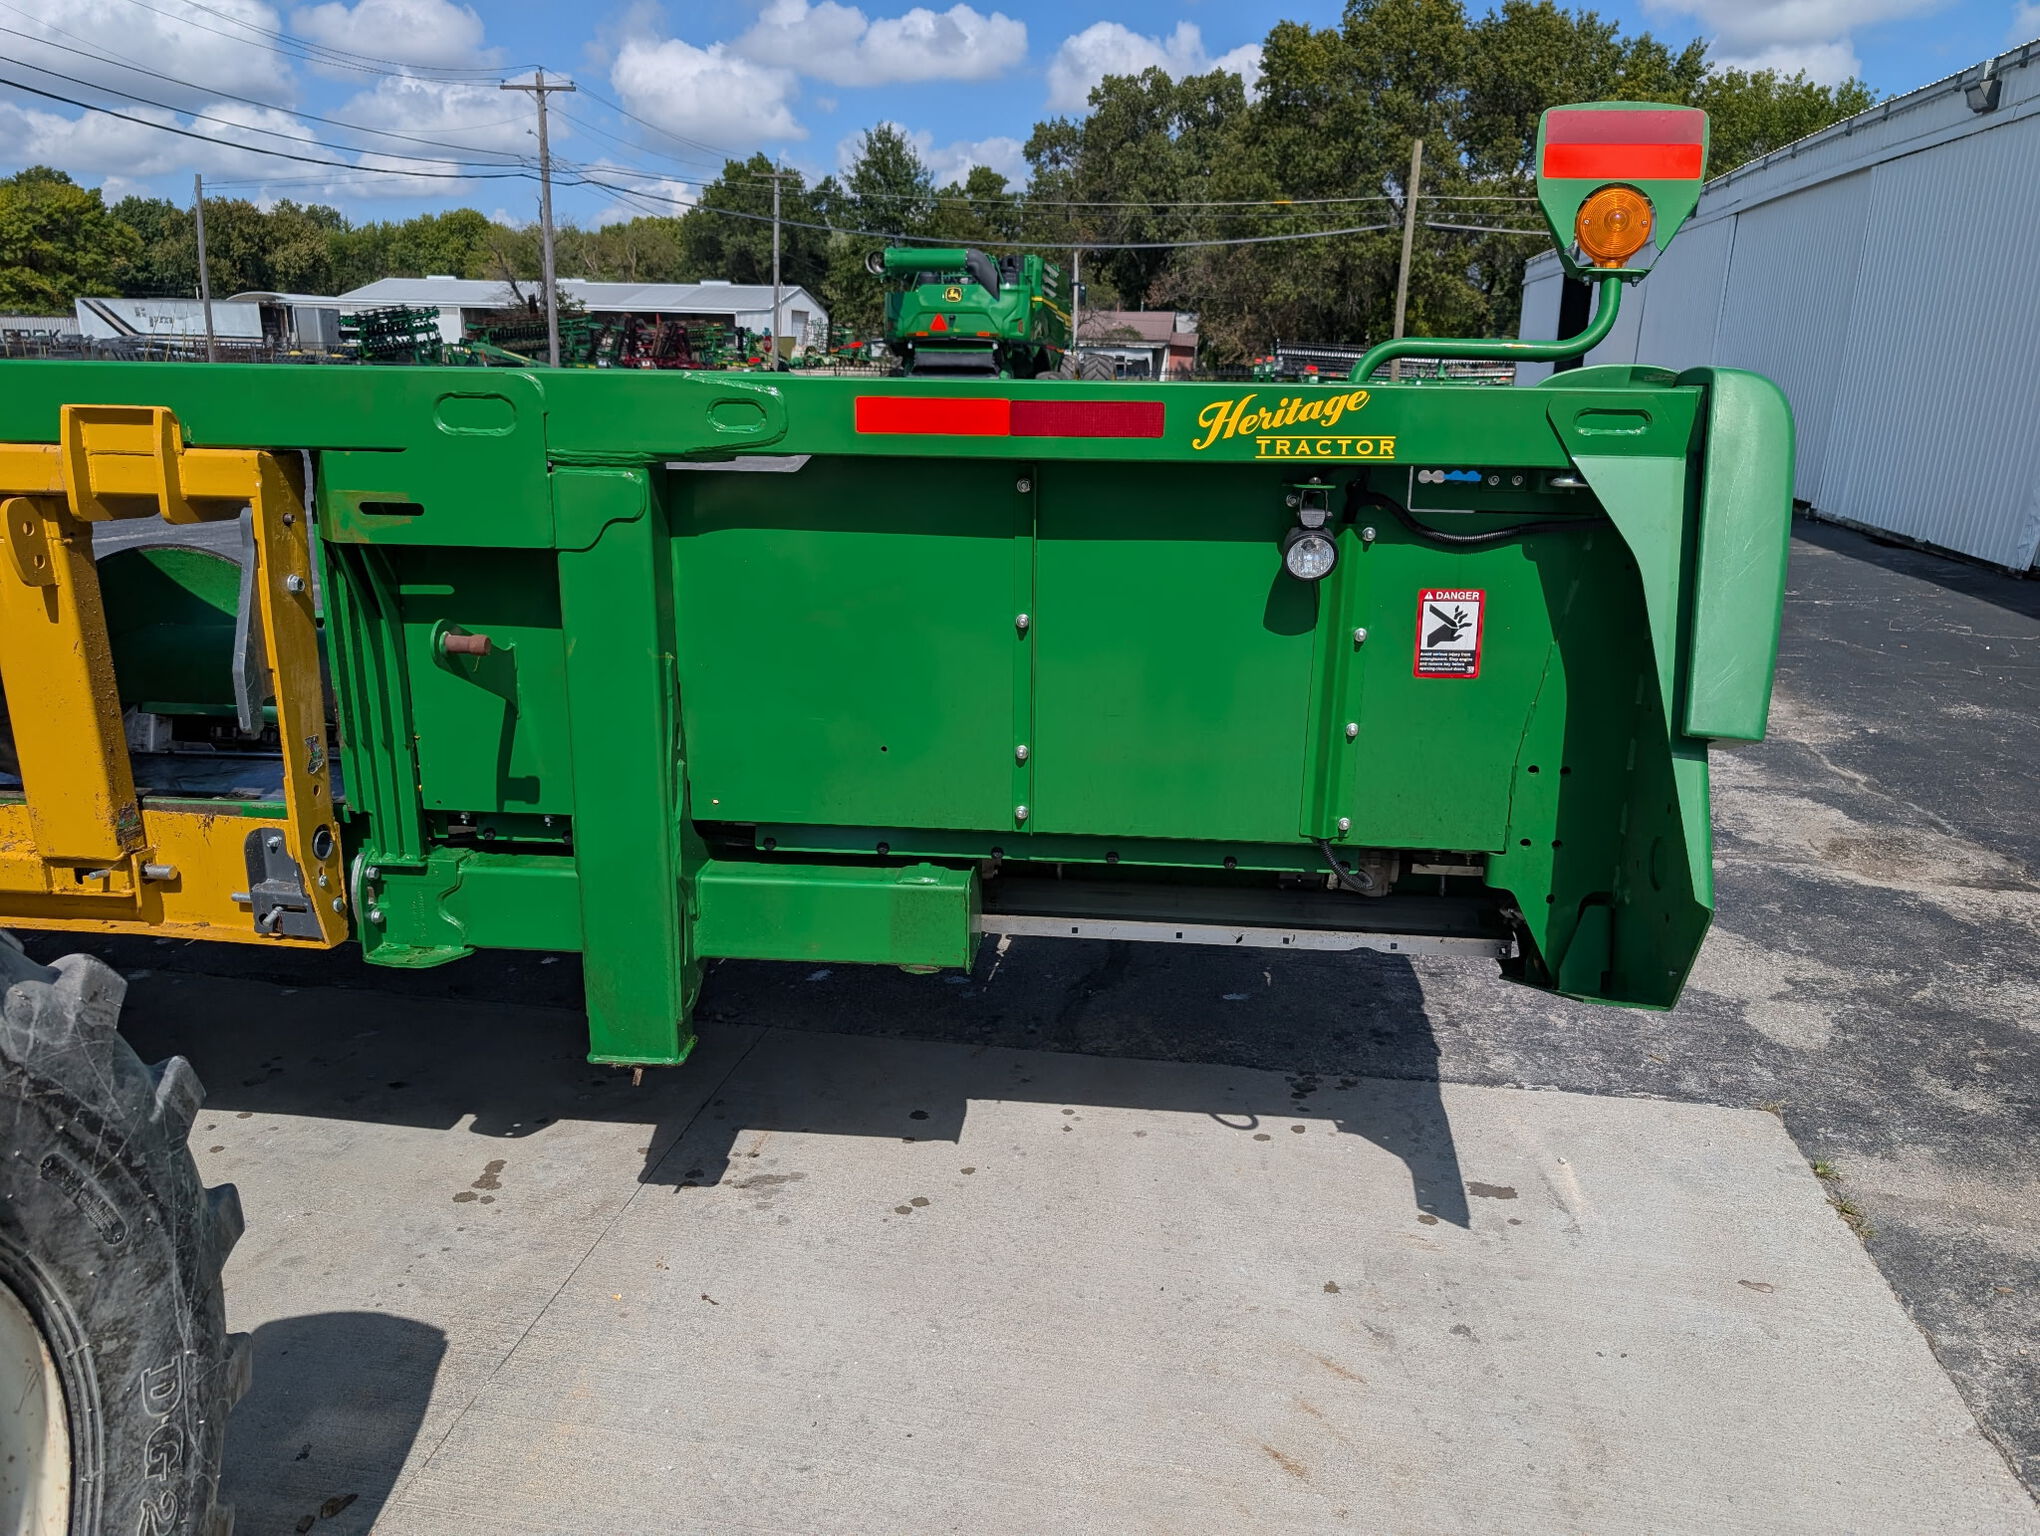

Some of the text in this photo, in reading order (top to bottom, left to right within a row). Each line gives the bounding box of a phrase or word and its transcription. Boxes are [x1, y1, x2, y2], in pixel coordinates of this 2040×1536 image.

[1192, 390, 1371, 450] Heritage
[1256, 439, 1394, 455] TRACTOR
[1436, 591, 1480, 600] DANGER
